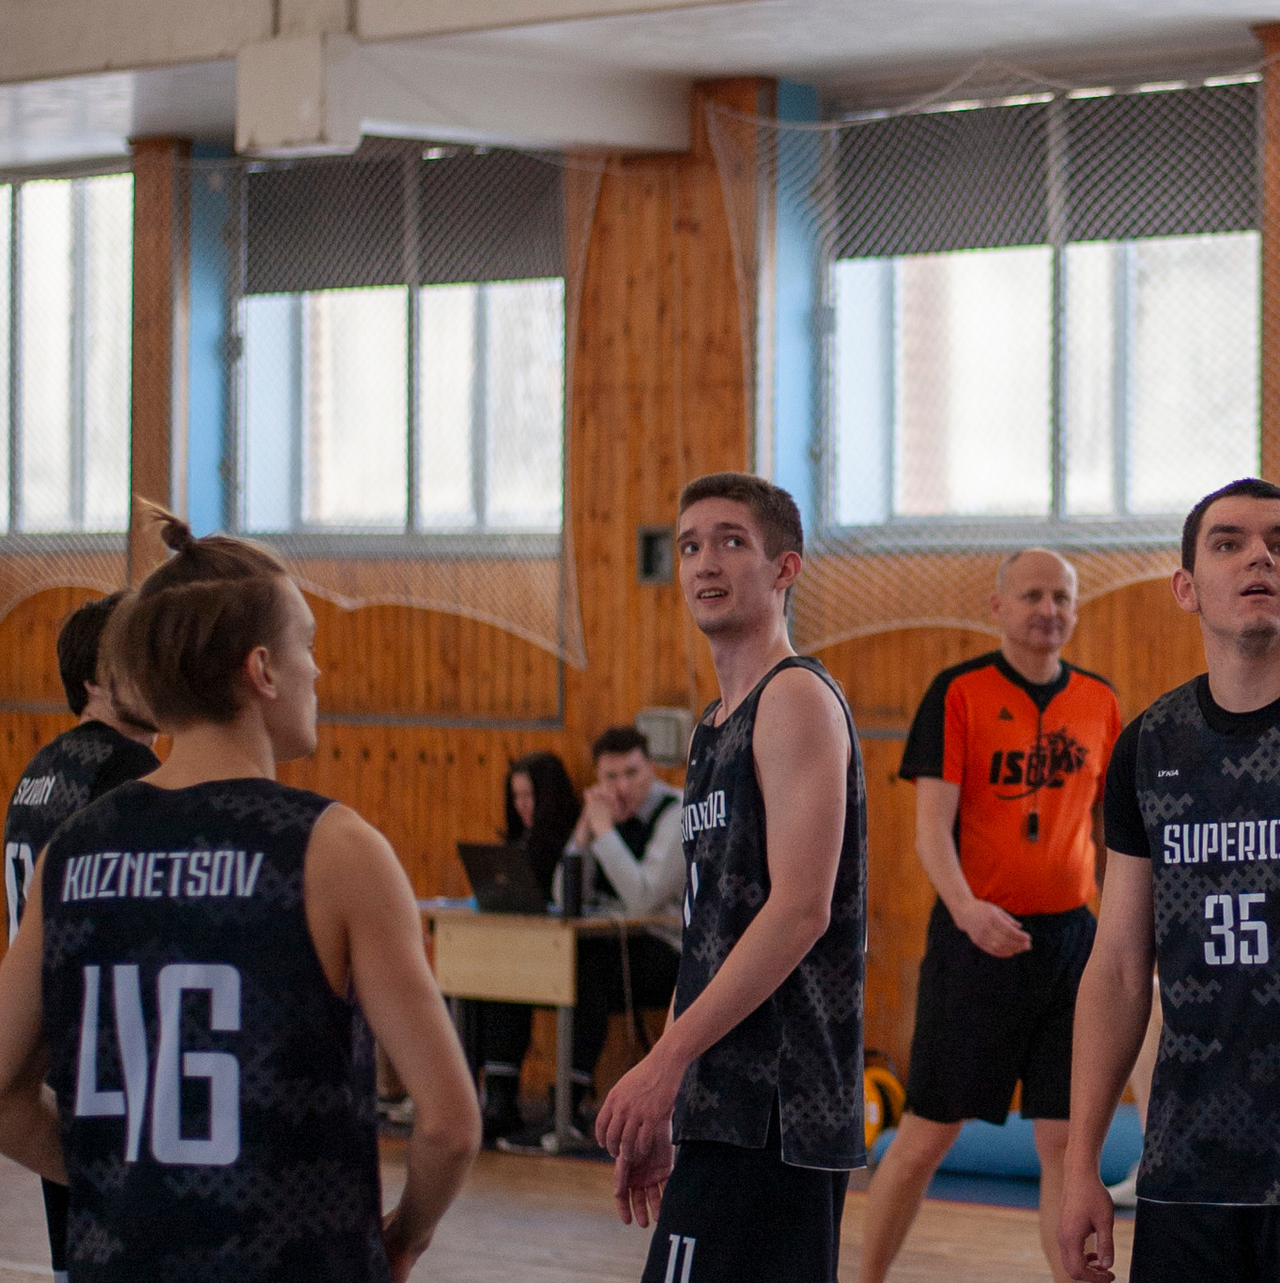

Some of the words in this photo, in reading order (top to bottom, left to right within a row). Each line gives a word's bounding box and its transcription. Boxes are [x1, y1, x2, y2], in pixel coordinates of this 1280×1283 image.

[62, 851, 264, 902] KUZNETSOV
[1204, 893, 1269, 965] 35
[75, 964, 241, 1165] 46
